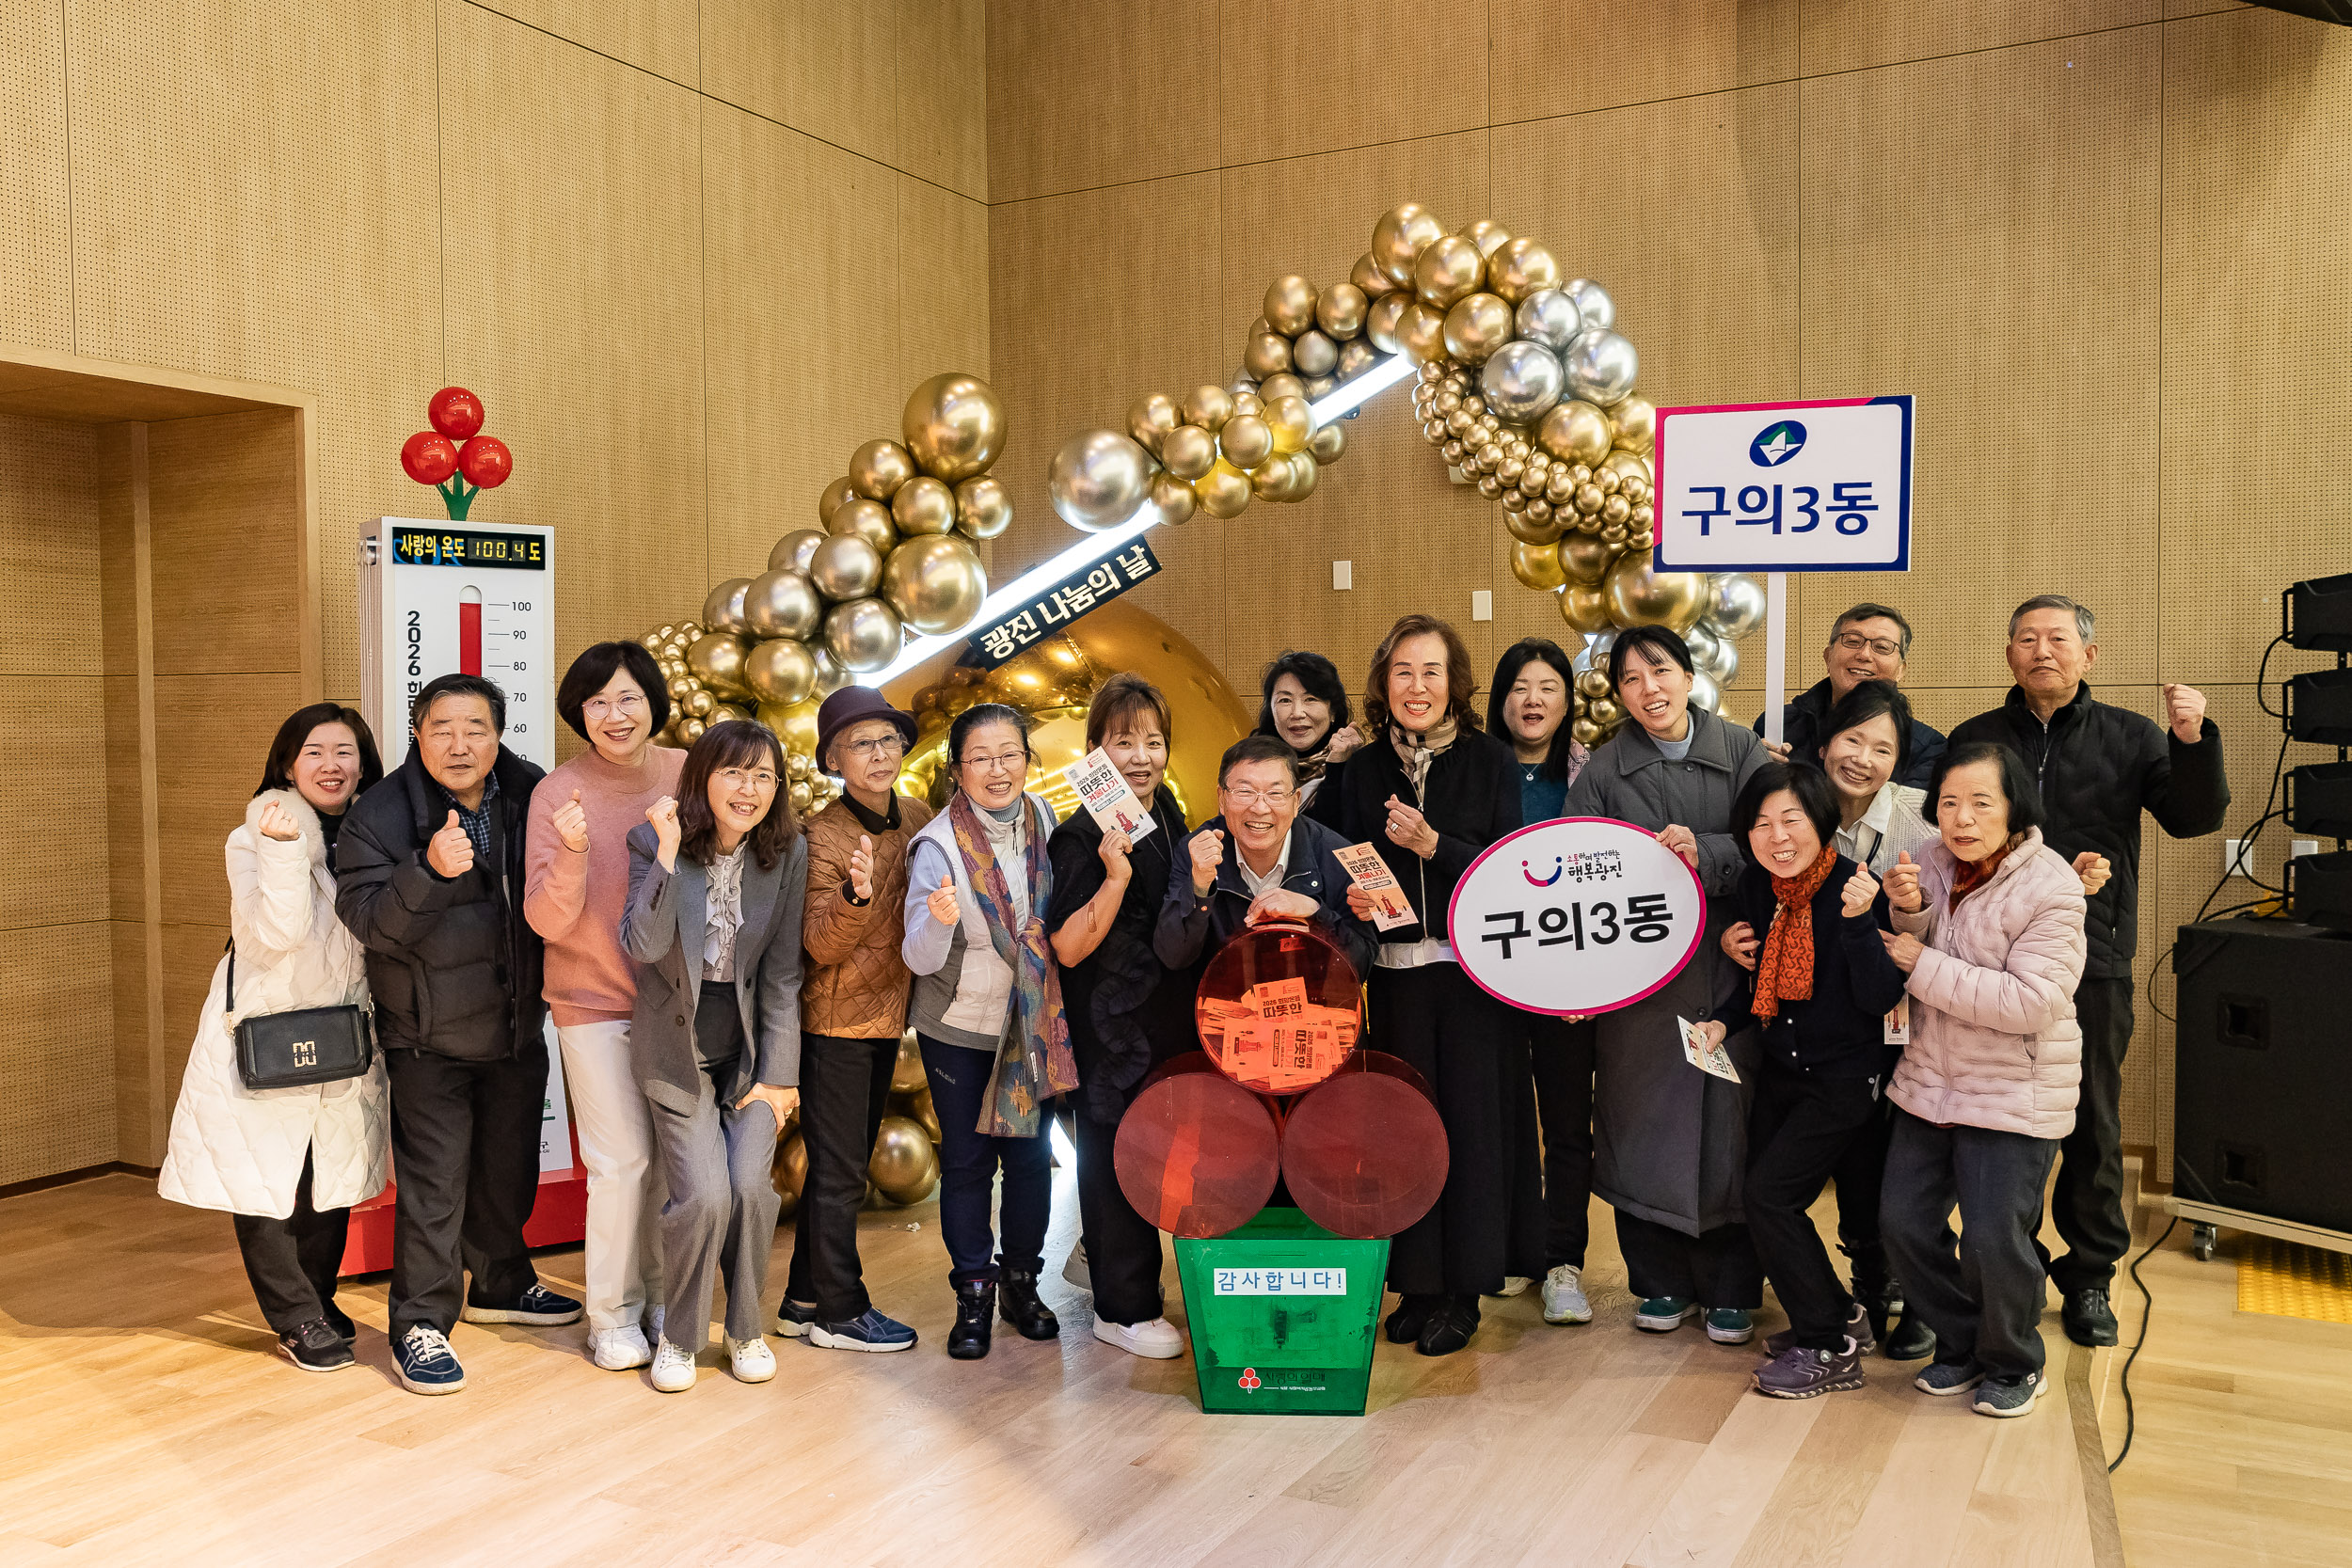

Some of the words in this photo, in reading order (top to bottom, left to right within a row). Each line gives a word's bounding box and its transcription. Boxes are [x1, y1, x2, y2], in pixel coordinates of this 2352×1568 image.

[1682, 482, 1879, 536] 구의3동
[401, 534, 437, 557] 사랑의
[441, 535, 466, 558] 온도
[476, 541, 524, 562] 100.4
[529, 542, 541, 562] 도
[512, 601, 532, 611] 100
[979, 610, 1041, 658] 광진
[1036, 562, 1121, 625] 나눔의
[1116, 545, 1152, 580] 날
[407, 610, 421, 676] 2026
[513, 630, 527, 640] 90
[513, 661, 527, 672] 80
[513, 692, 527, 703] 70
[513, 723, 527, 734] 60
[1080, 768, 1114, 796] 따뜻한
[1086, 778, 1119, 803] 겨울나기
[1349, 860, 1381, 874] 따뜻한
[1566, 852, 1593, 865] 소통하며
[1593, 848, 1621, 863] 발전하는
[1567, 861, 1623, 883] 행복광진
[1481, 894, 1673, 959] 구의3동
[1263, 1002, 1302, 1018] 따뜻한
[1295, 1030, 1307, 1069] 따뜻한
[1217, 1271, 1342, 1291] 감사합니다!
